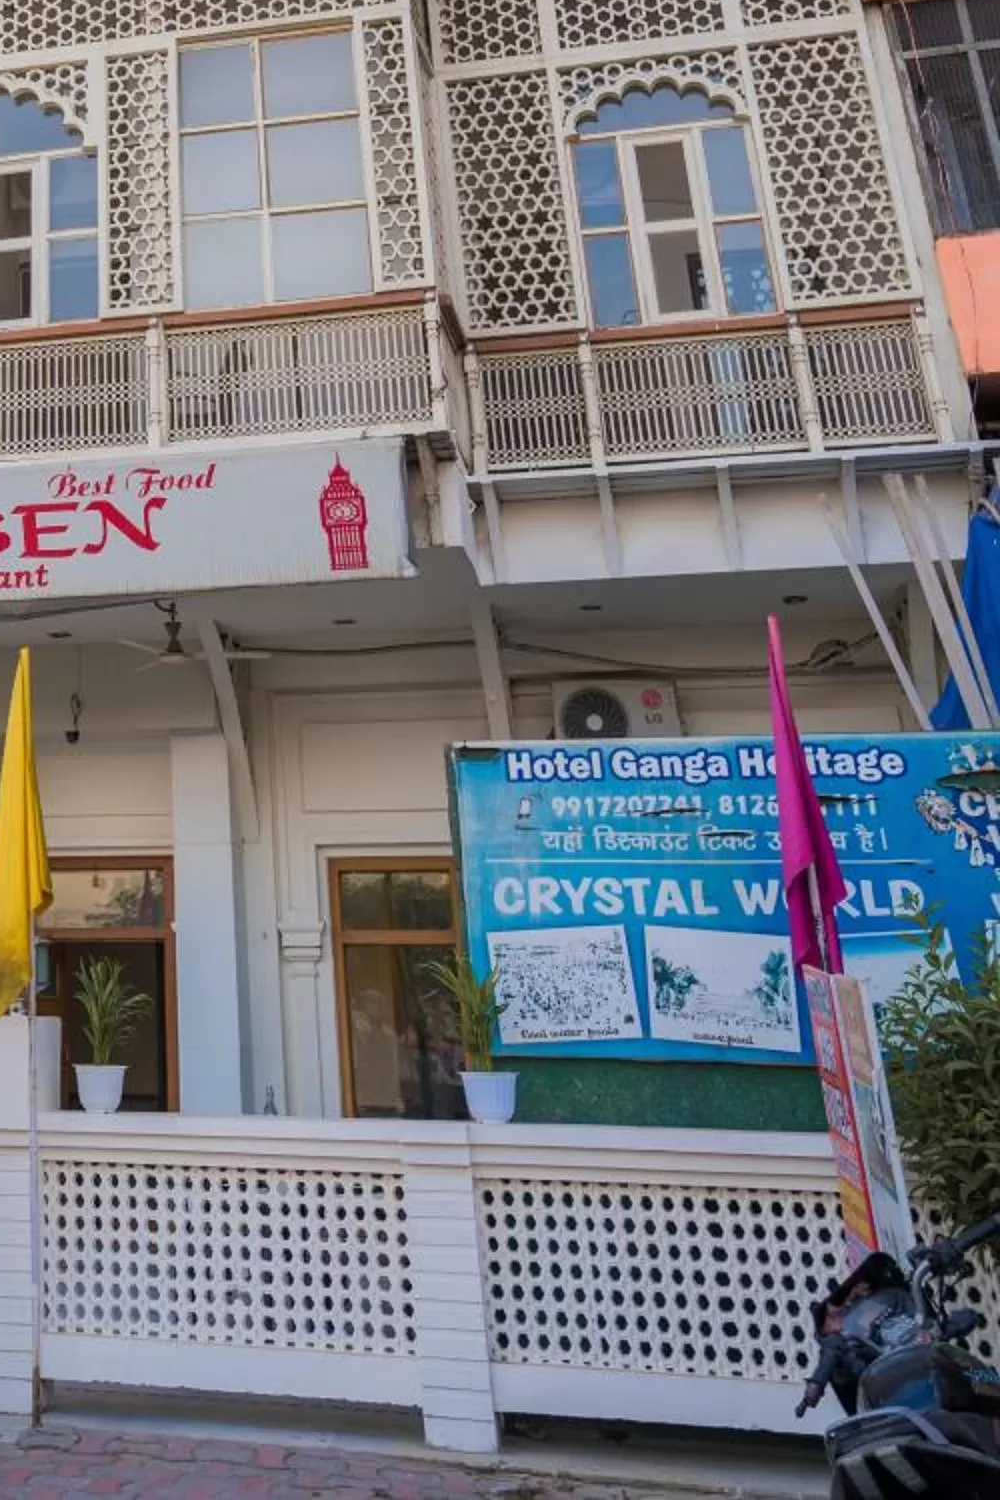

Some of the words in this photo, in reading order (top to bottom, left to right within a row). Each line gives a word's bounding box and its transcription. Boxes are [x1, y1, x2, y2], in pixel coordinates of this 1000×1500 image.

[48, 470, 115, 498] Best
[126, 463, 216, 498] Food
[645, 712, 663, 725] LG
[507, 750, 601, 780] Hotel
[612, 751, 729, 783] Ganga
[739, 747, 905, 782] Hitage
[493, 876, 719, 918] CRYSTAL
[733, 878, 925, 919] WRLD
